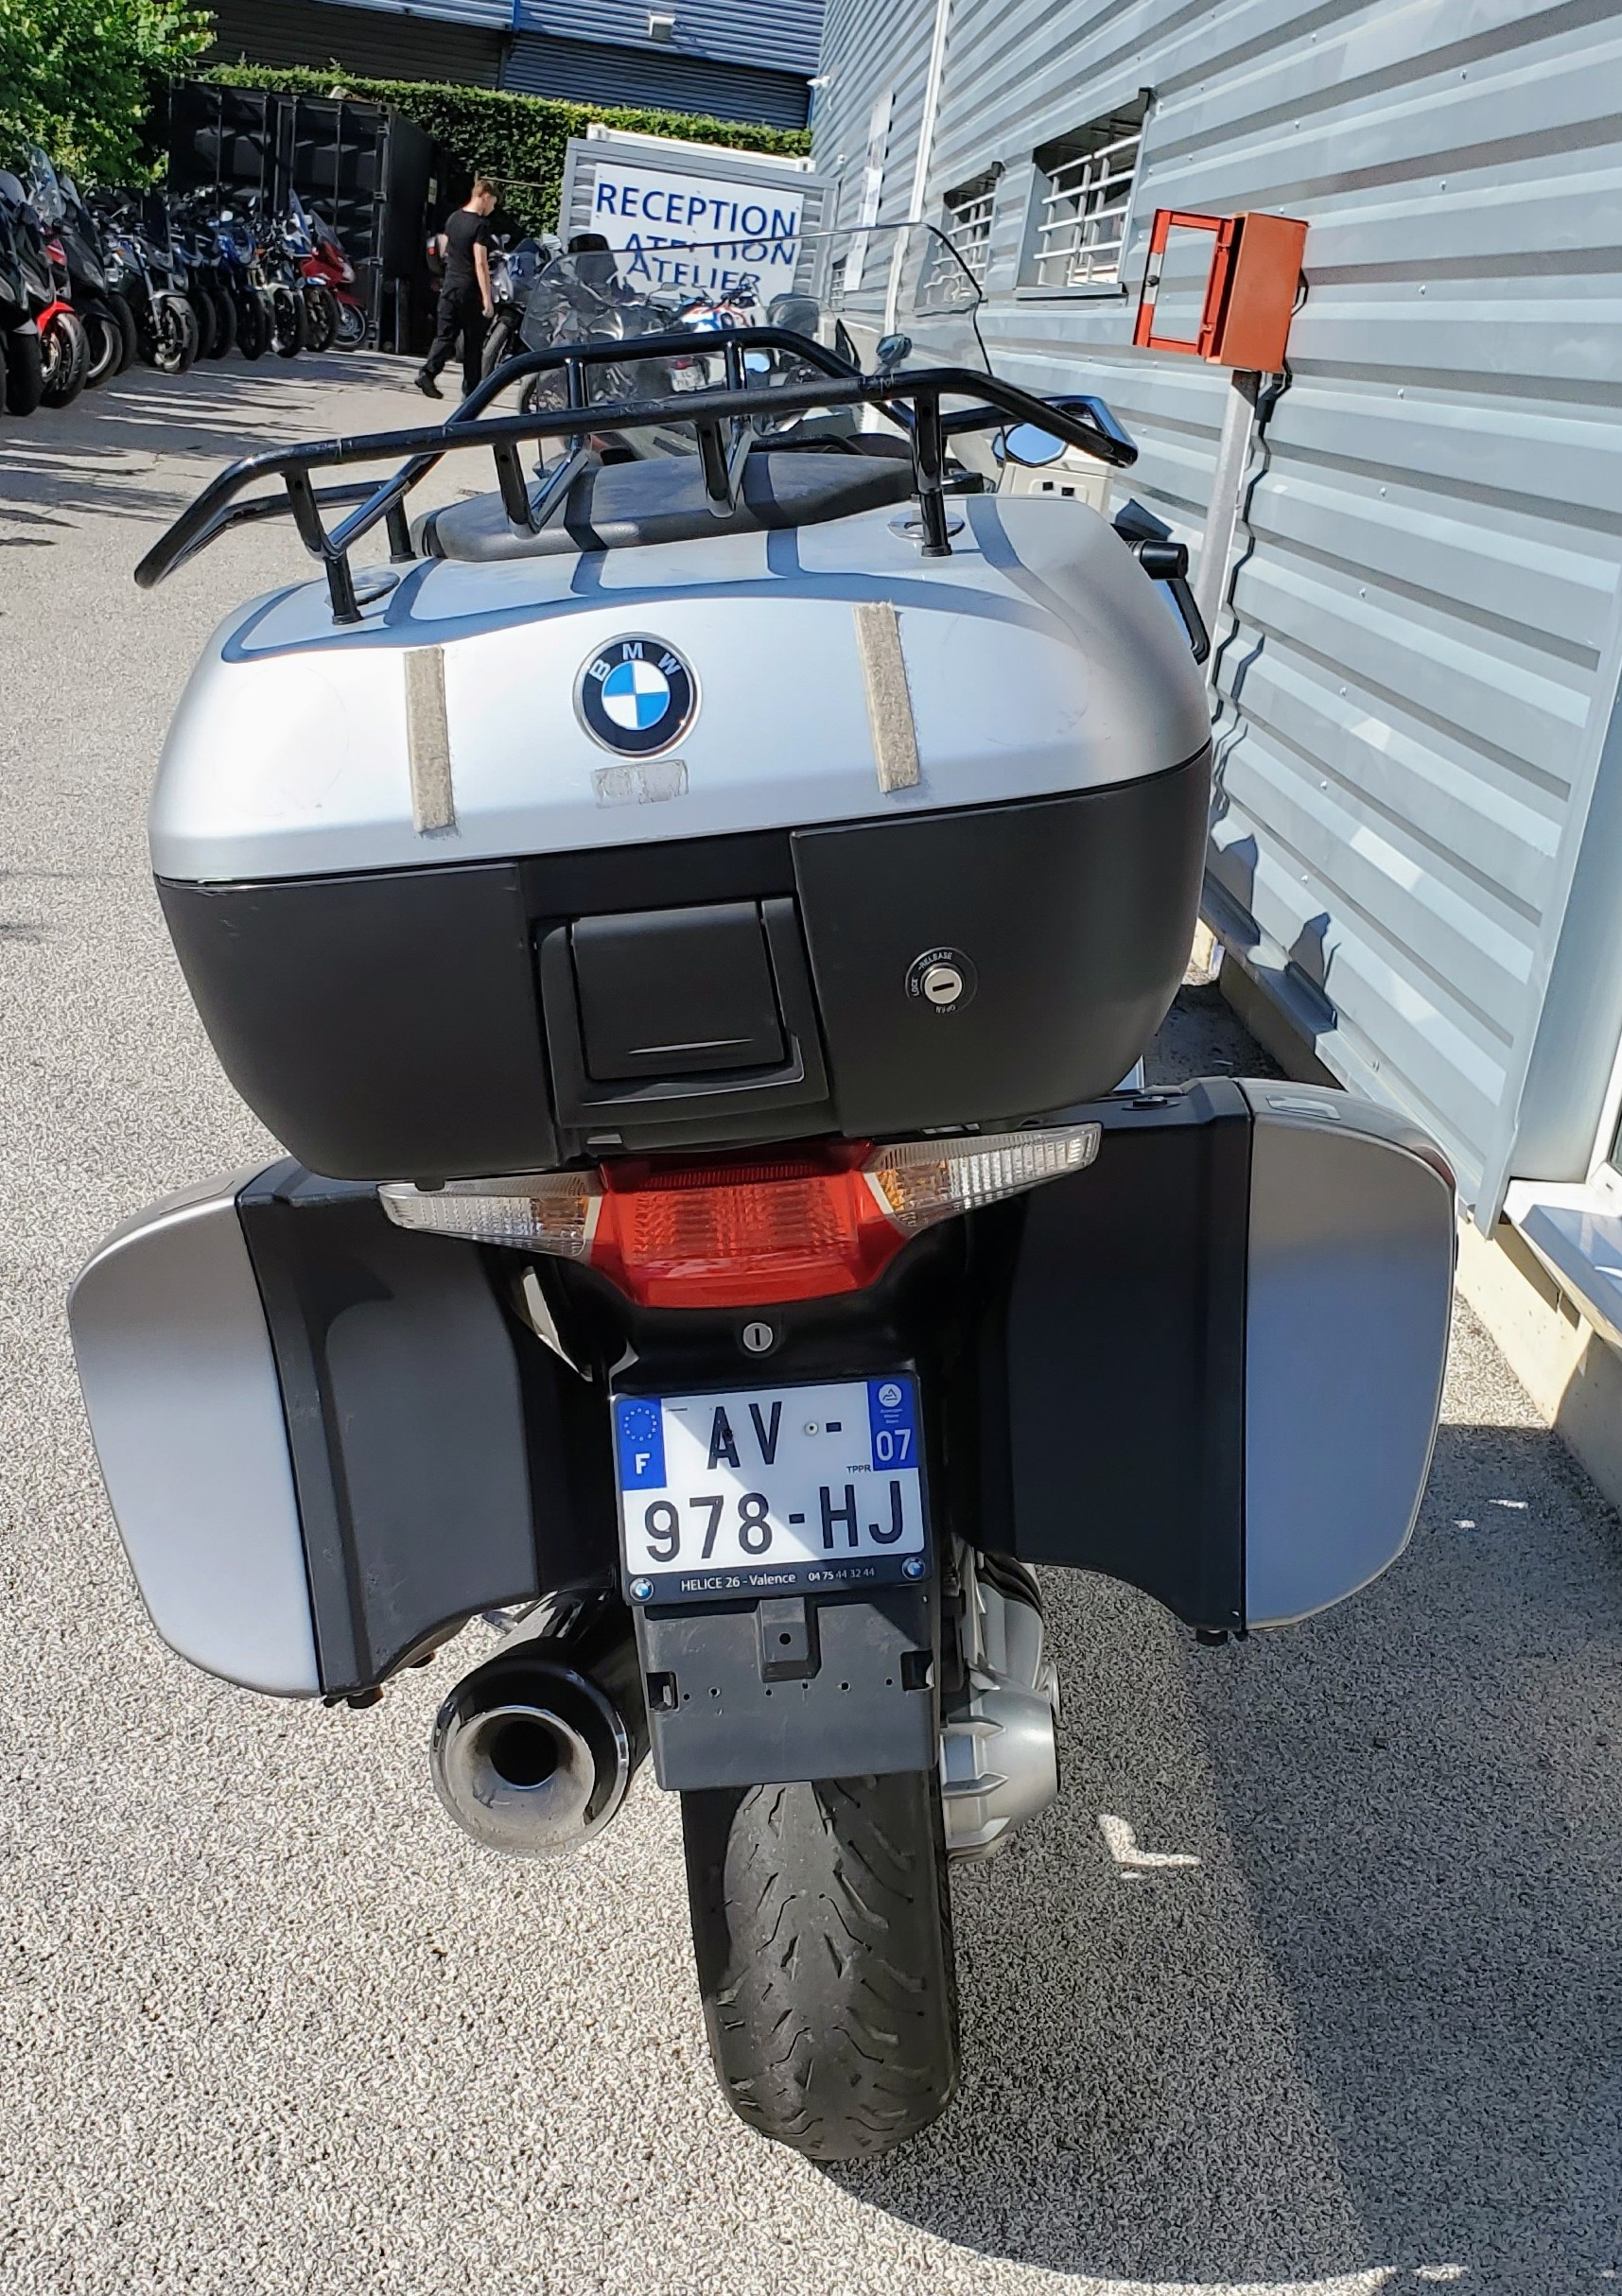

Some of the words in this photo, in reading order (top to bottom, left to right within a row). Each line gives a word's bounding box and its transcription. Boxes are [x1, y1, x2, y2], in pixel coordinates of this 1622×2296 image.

[596, 183, 796, 237] RECEPTION
[626, 251, 761, 291] ATELIER
[589, 642, 682, 682] BMW
[911, 978, 920, 997] LOCK
[876, 1429, 911, 1461] 07
[635, 1452, 650, 1475] F
[846, 1464, 872, 1474] TPPR
[644, 1480, 904, 1562] 978-HJ
[681, 1576, 723, 1592] HELICE
[725, 1576, 741, 1589] 26
[748, 1573, 796, 1587] Valence
[808, 1573, 820, 1582] 04
[822, 1571, 834, 1580] 75
[863, 1567, 875, 1577] 44
